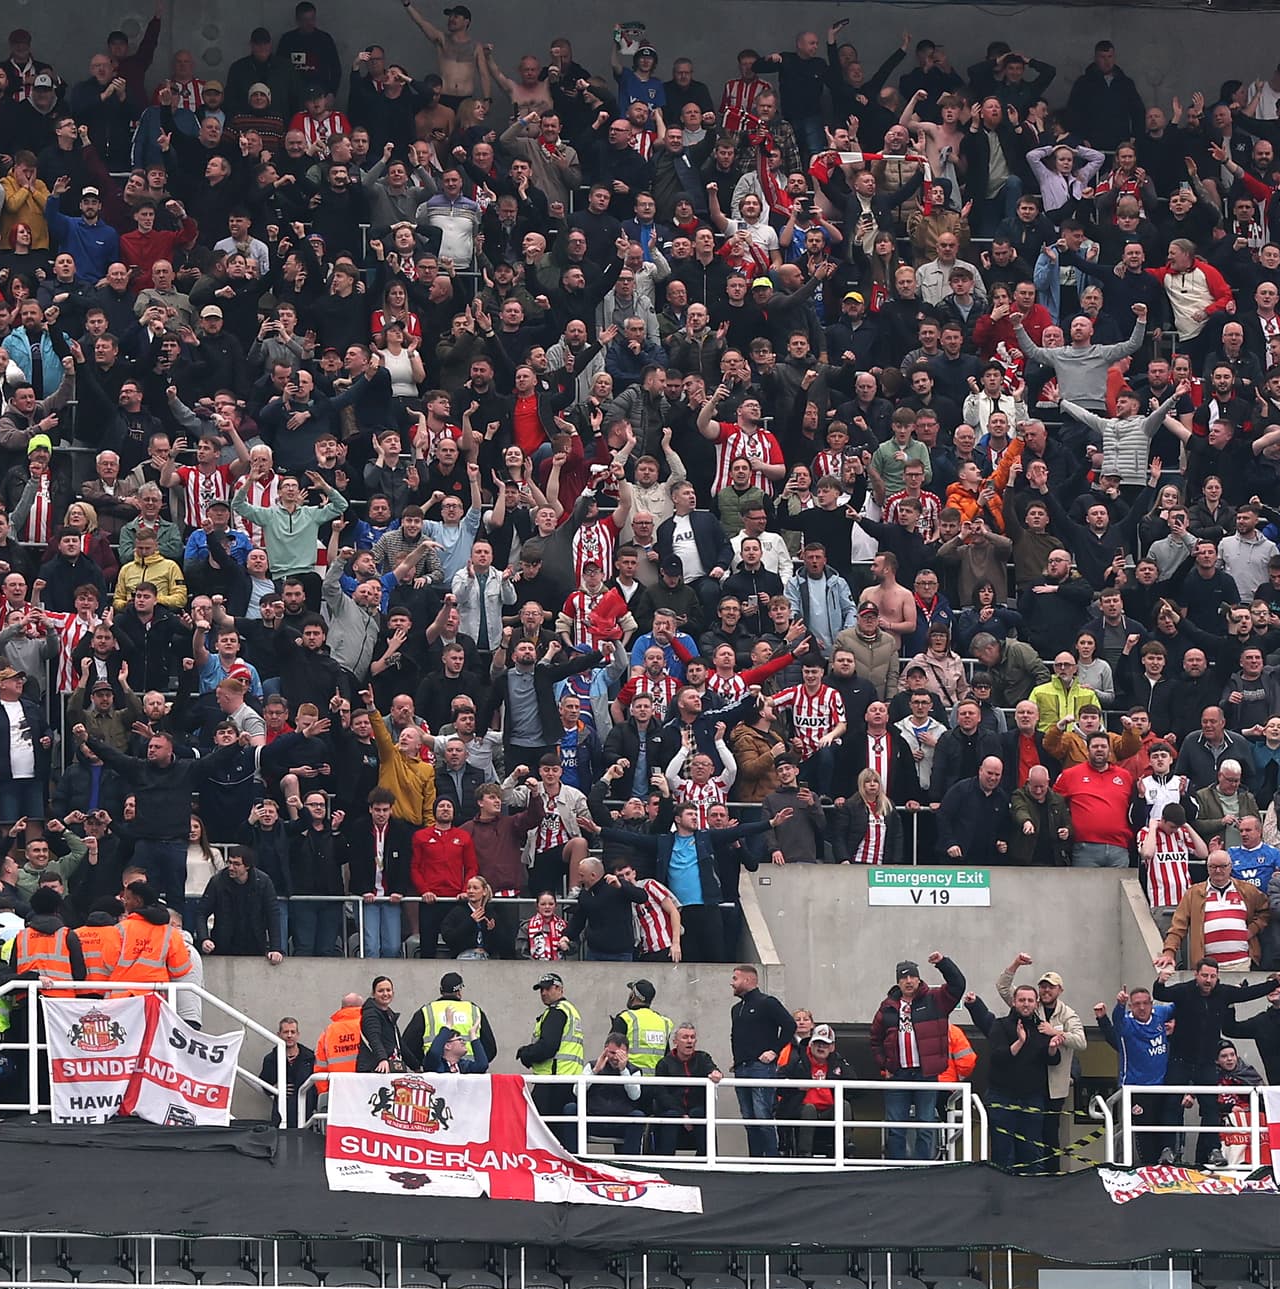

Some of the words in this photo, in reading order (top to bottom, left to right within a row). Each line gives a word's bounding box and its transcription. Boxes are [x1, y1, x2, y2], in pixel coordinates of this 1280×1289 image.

[794, 716, 827, 728] VAUX
[1157, 852, 1187, 862] VAUX
[874, 871, 952, 886] Emergency
[956, 871, 984, 884] Exit
[910, 889, 923, 904] V
[930, 889, 950, 904] 19
[169, 1027, 228, 1063] SR5
[339, 1033, 355, 1043] SAFC
[1148, 1043, 1167, 1058] W88
[179, 1079, 219, 1102] AFC
[340, 1136, 537, 1171] SUNDERLAND
